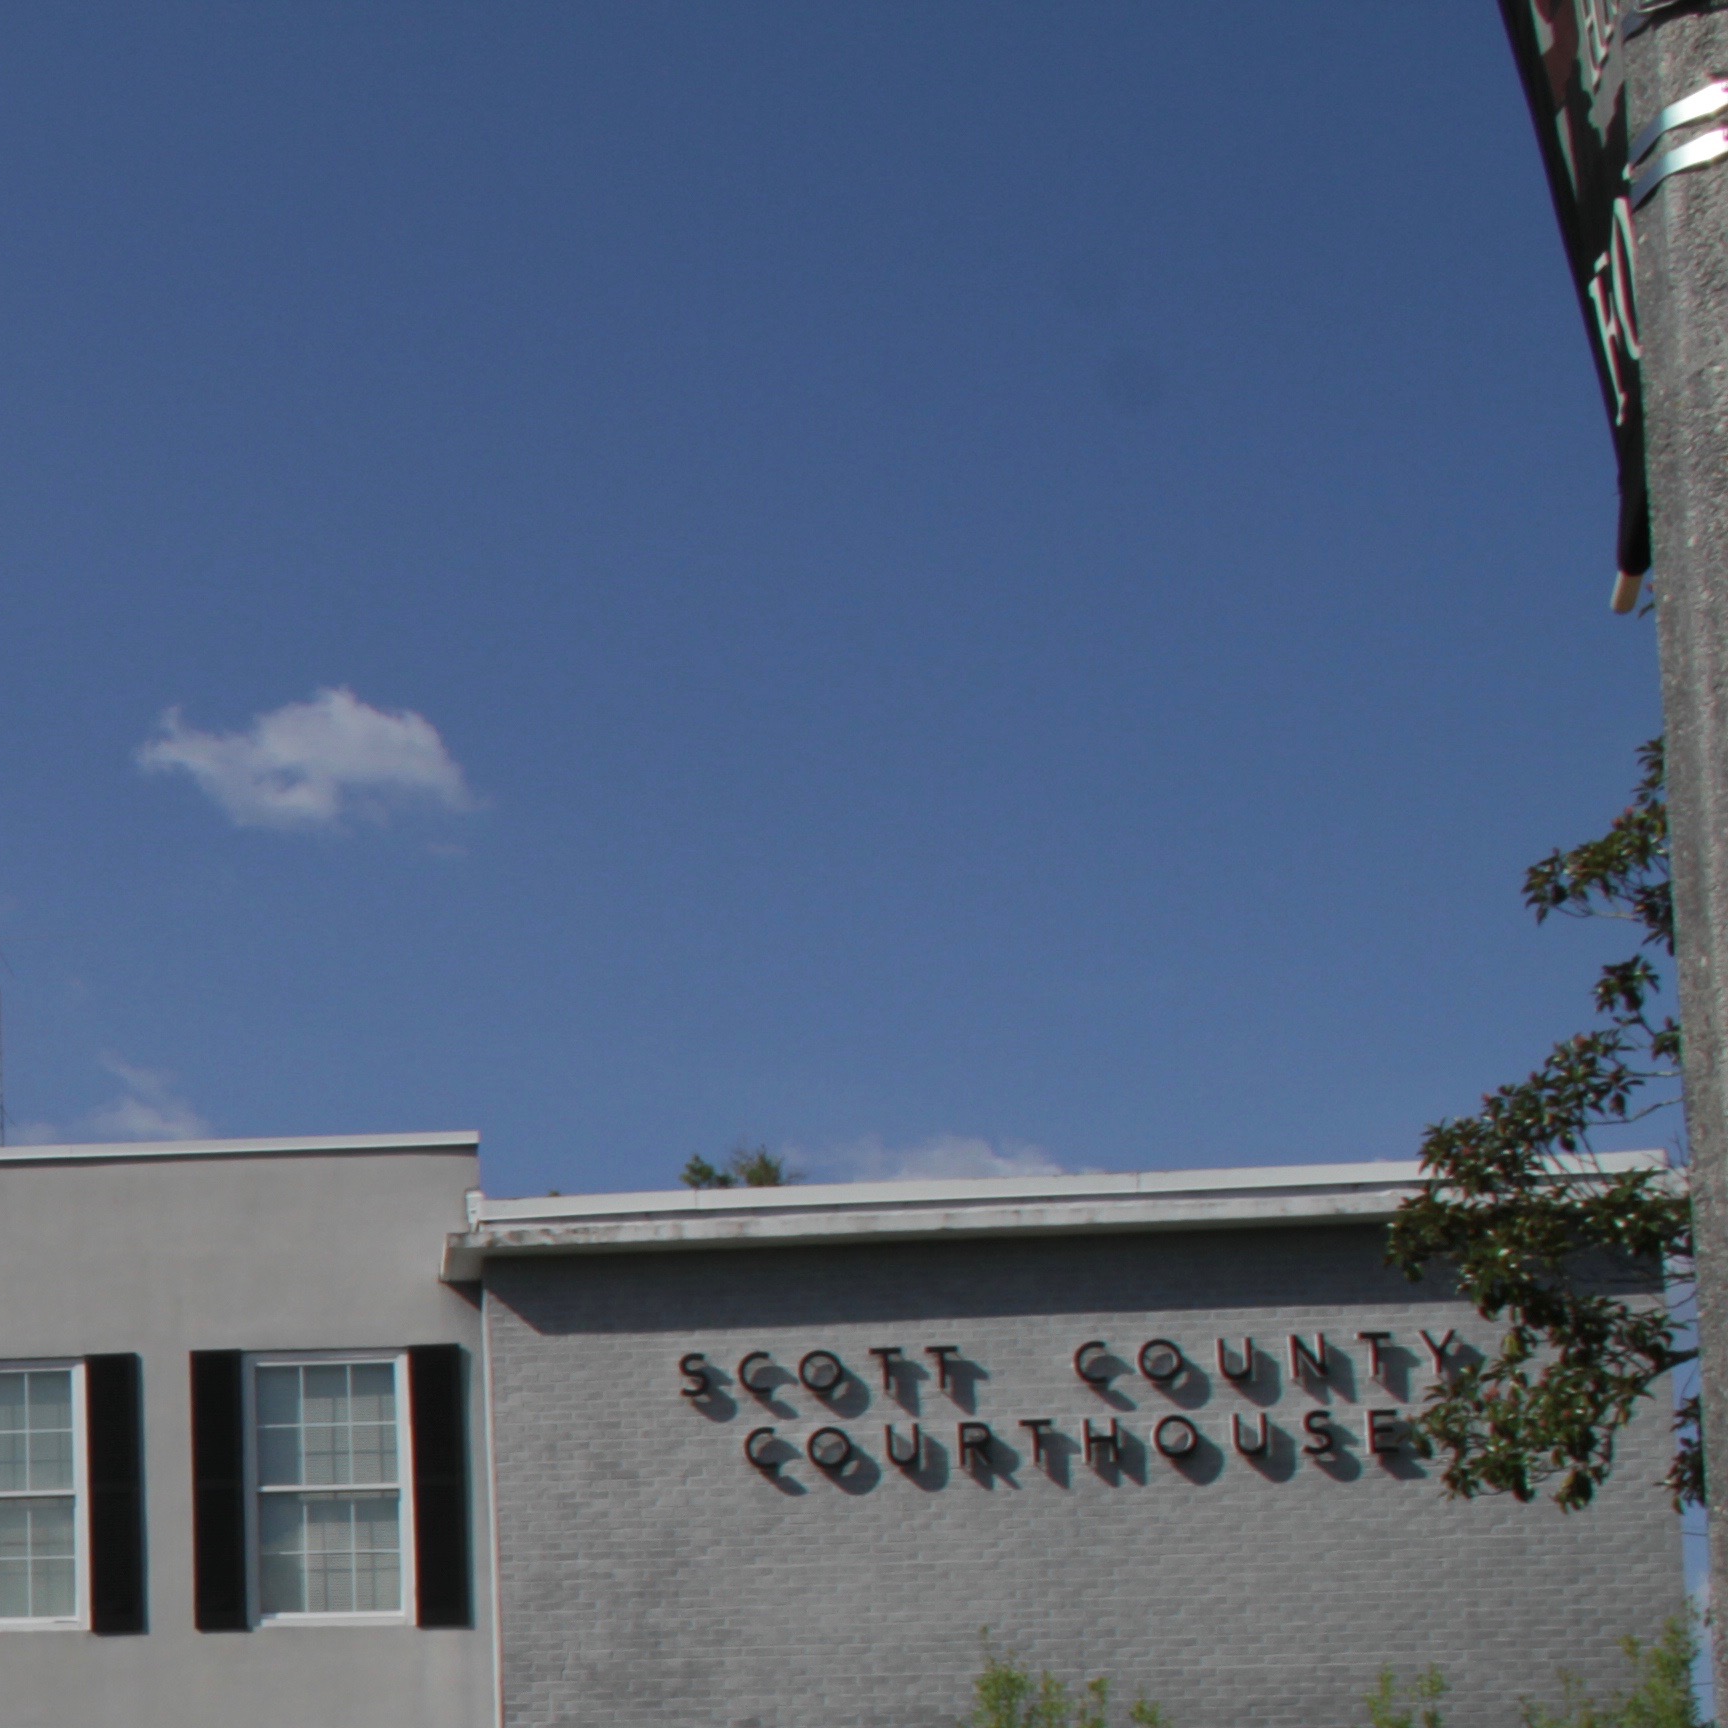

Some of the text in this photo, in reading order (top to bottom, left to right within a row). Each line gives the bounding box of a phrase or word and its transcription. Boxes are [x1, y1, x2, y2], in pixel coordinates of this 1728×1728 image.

[680, 1329, 1456, 1397] SCOTT COUNTY
[744, 1409, 1400, 1470] COURTHOUSE
